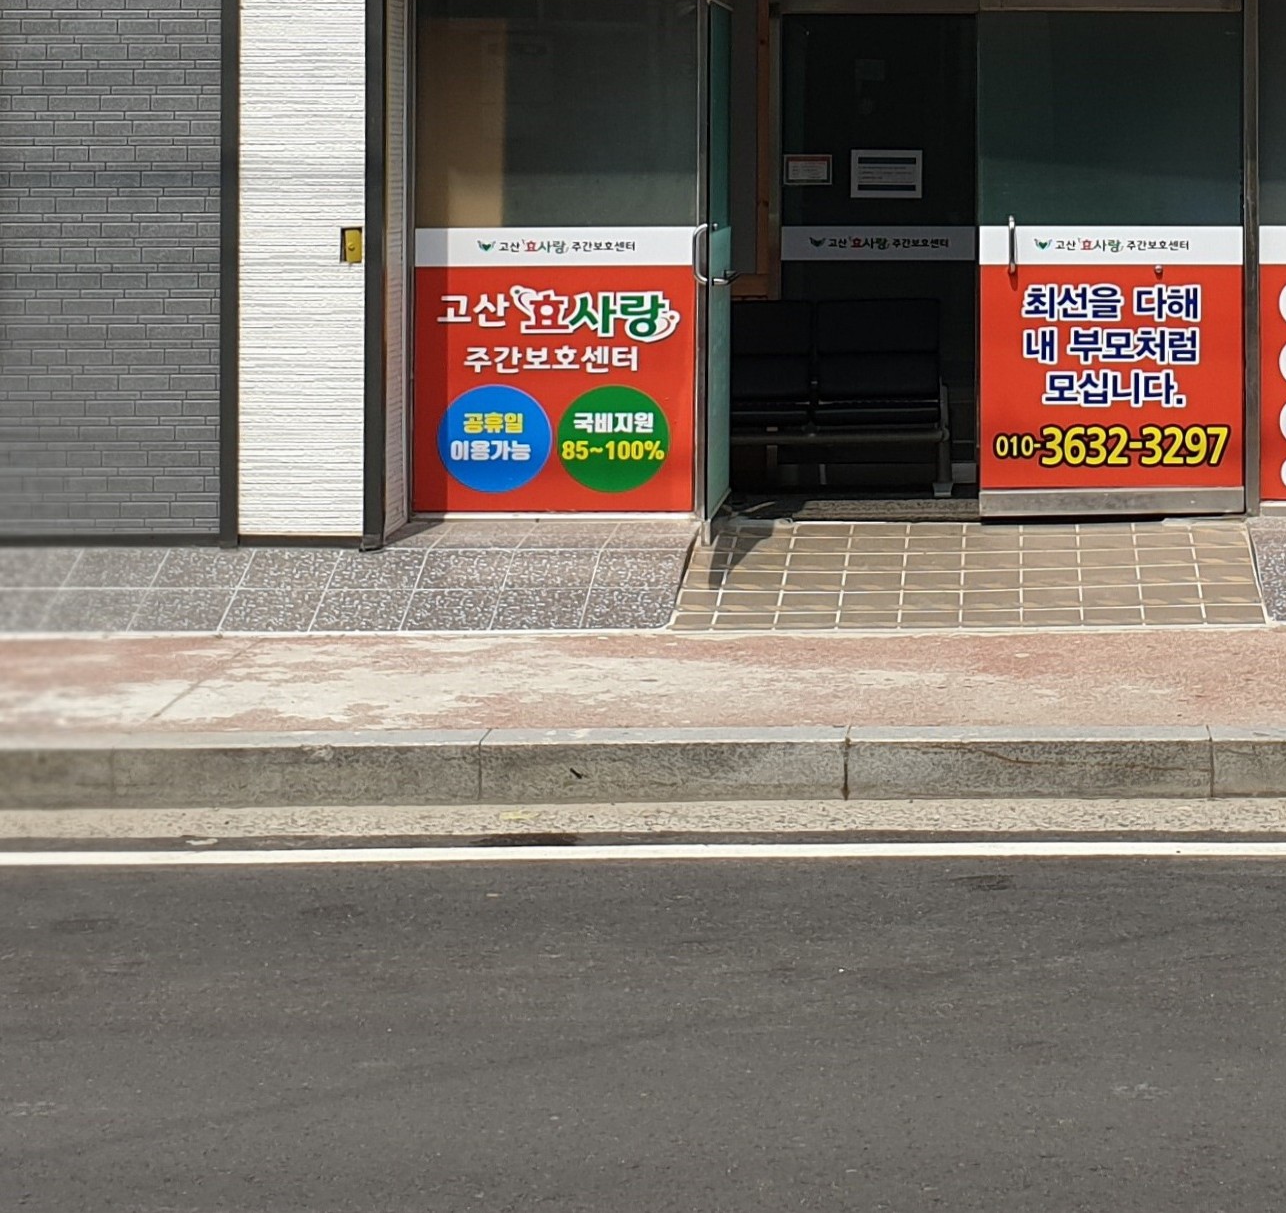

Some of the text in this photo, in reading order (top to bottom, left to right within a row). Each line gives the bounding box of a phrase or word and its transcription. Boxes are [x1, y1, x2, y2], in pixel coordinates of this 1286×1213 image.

[498, 239, 636, 254] 고산 효사랑 주간보호센터
[1055, 238, 1190, 253] 고산 효사랑 주간보호센터
[436, 289, 674, 342] 고산 효사랑
[1022, 285, 1201, 322] 최선을 다해
[1023, 328, 1199, 364] 내 부모처럼
[463, 345, 639, 374] 주간보호센터
[1043, 371, 1185, 406] 모십니다.
[463, 412, 523, 434] 공휴일
[573, 412, 654, 434] 국비지원
[450, 439, 531, 462] 이용가능
[562, 440, 665, 461] 85~100%
[995, 425, 1229, 466] 010-3632-3297
